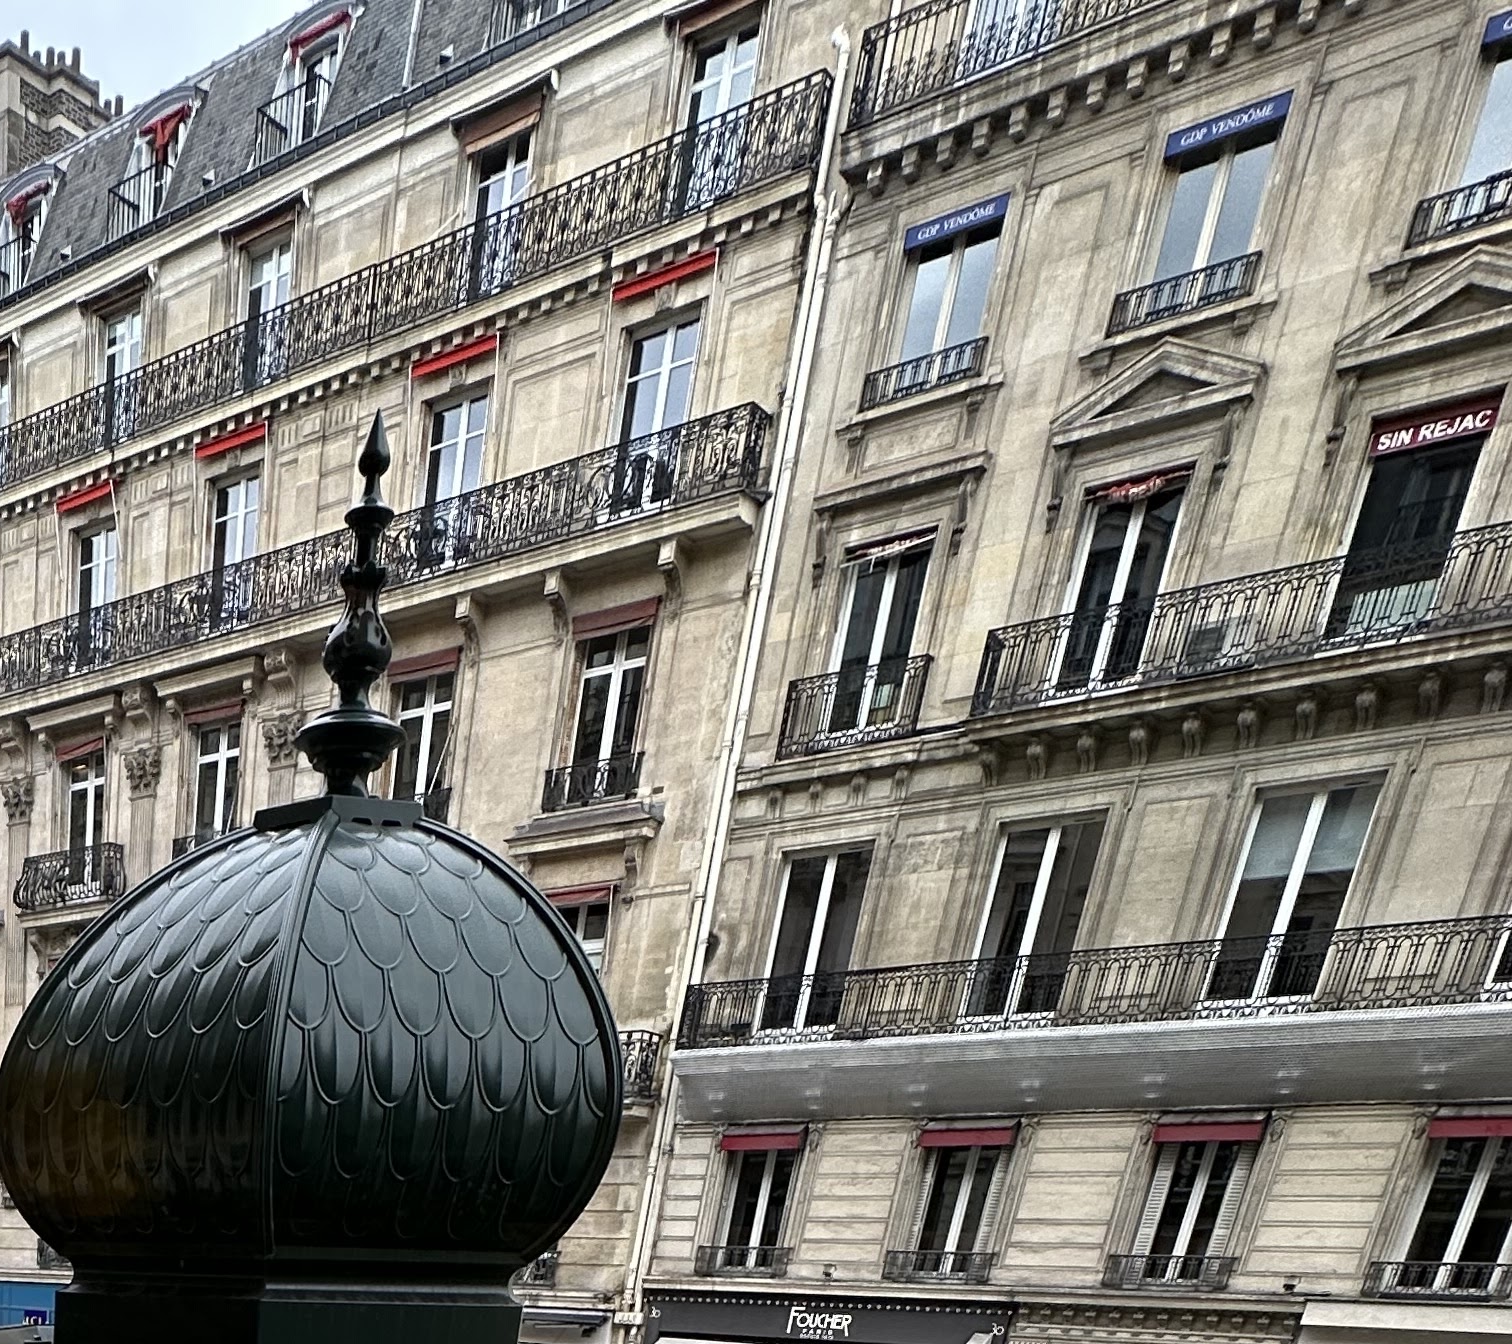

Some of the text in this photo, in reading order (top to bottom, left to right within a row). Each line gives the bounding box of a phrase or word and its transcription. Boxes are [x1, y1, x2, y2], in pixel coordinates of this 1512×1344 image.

[1180, 102, 1275, 146] GDP VENDÔME
[918, 203, 996, 240] GDP VENDÔME
[1377, 410, 1493, 450] SIN REJAC
[786, 1306, 852, 1337] FOUCHER
